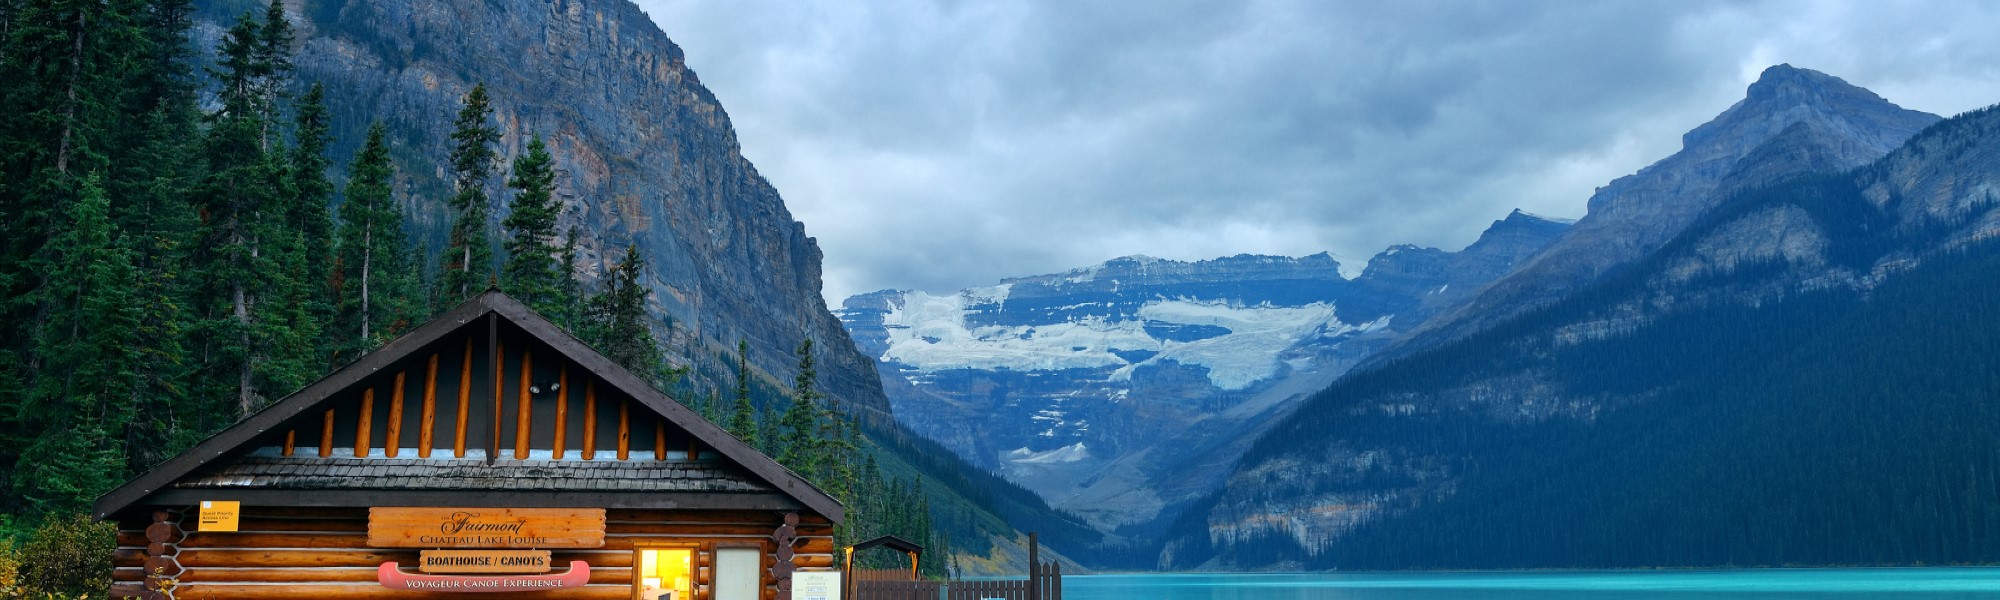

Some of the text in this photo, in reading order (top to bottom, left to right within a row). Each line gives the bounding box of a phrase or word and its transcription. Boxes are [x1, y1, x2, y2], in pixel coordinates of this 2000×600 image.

[441, 511, 526, 534] Fairmont
[420, 535, 547, 544] CHATEAU LAKE LOUISE
[427, 556, 491, 566] BOATHOUSE
[501, 556, 544, 566] CANOTS
[406, 578, 563, 588] VOYAGEUR CANOE EXPERIENCE
